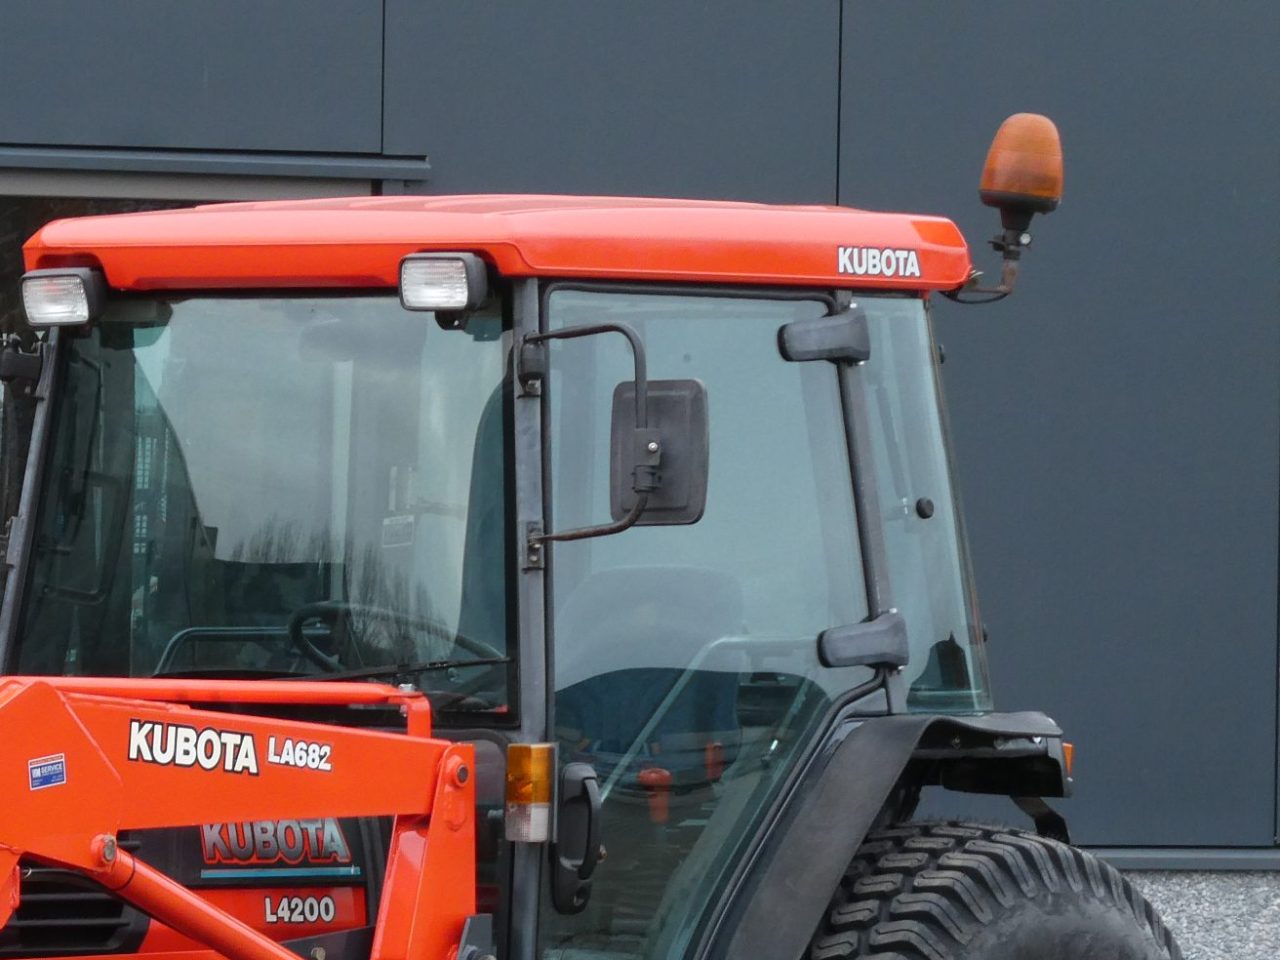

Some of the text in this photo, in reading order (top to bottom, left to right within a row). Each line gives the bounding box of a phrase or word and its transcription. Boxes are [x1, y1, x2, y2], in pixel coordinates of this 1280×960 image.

[837, 246, 921, 277] KUBOTA
[128, 719, 333, 775] KUBOTA LA682
[202, 817, 351, 864] KUBOTA
[264, 896, 335, 923] L4200
